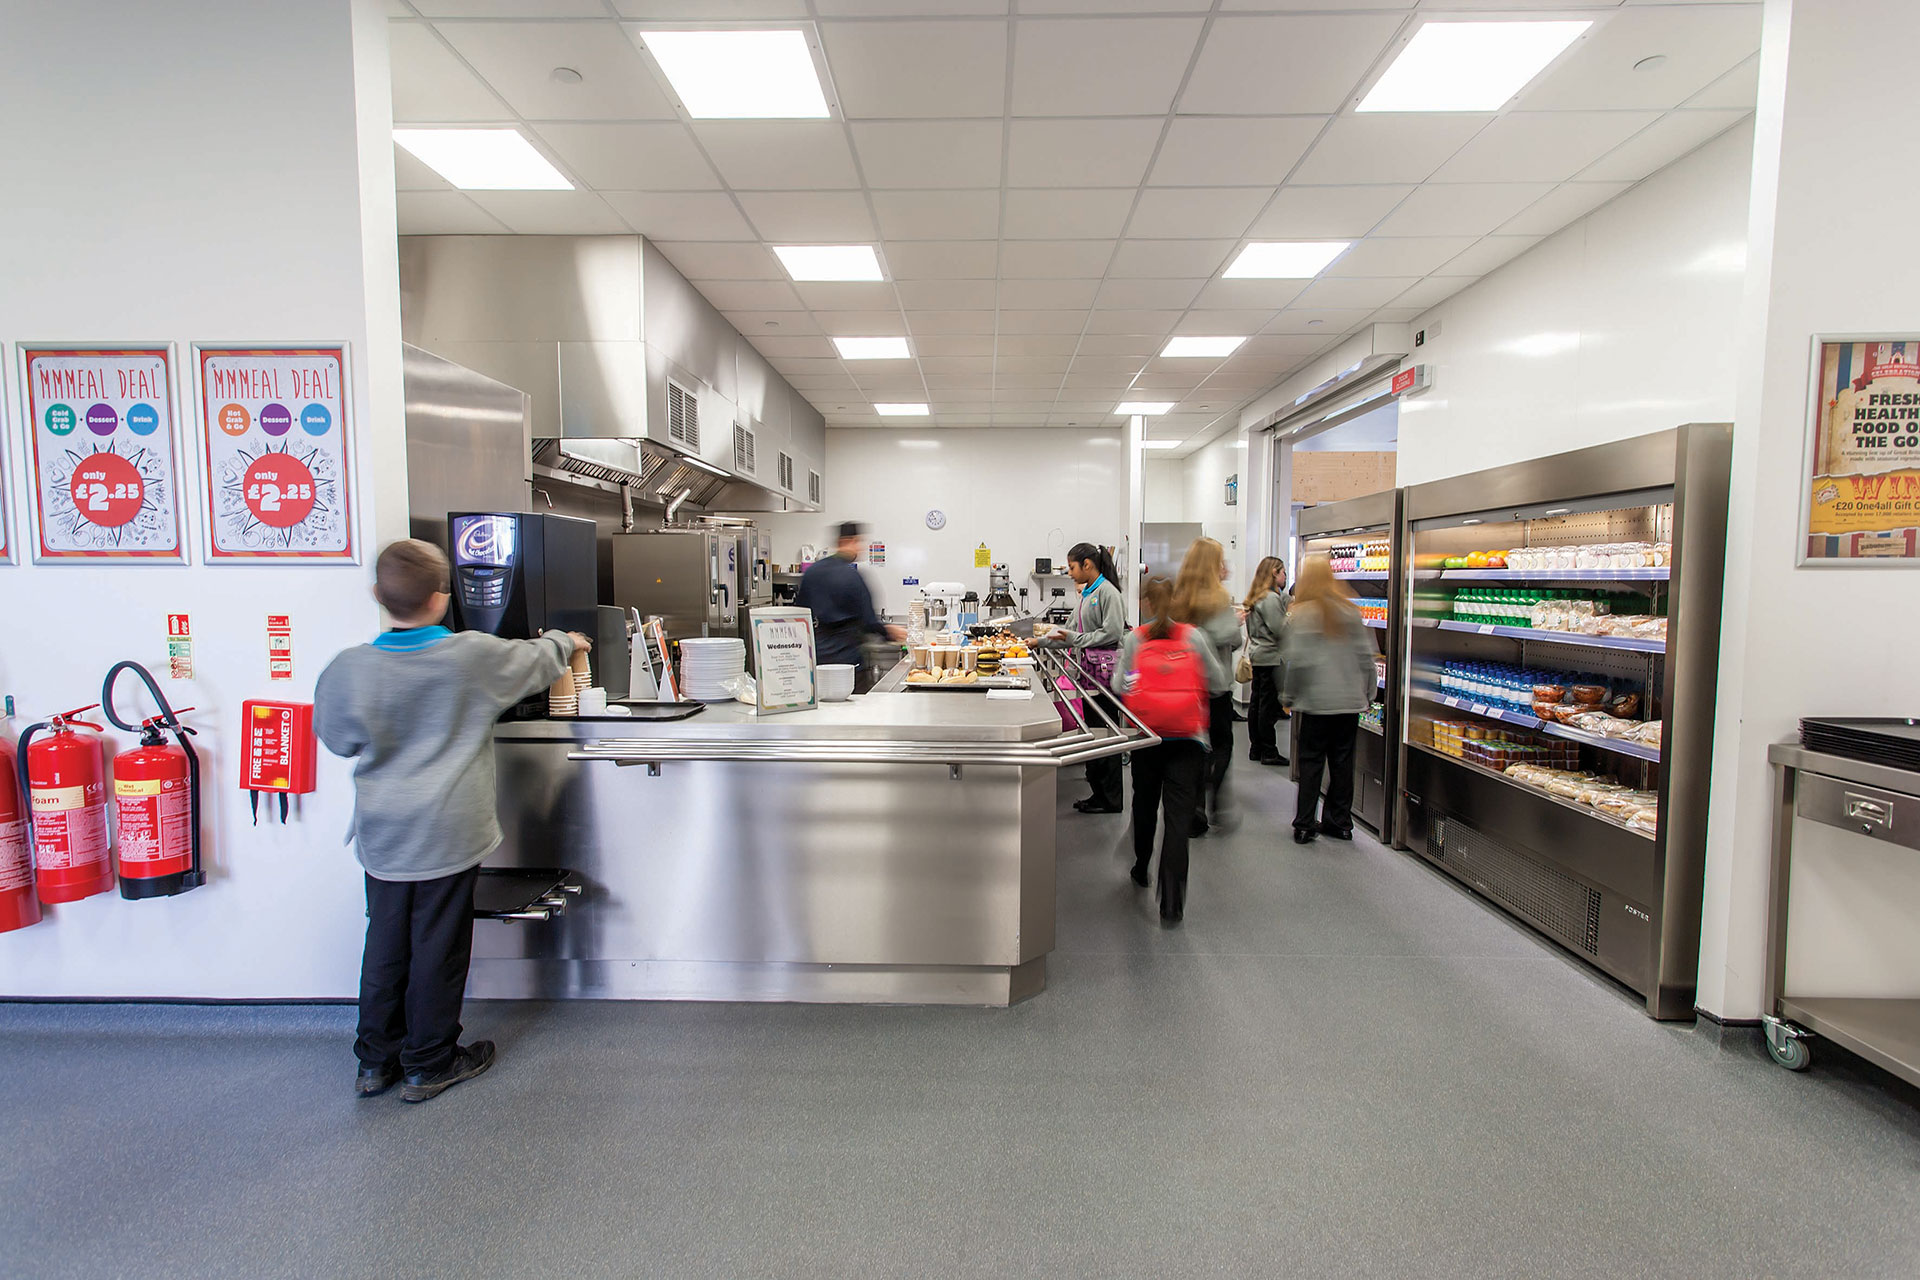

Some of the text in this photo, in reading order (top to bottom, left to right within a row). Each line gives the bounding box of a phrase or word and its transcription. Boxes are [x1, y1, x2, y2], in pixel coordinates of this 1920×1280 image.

[40, 368, 160, 399] MMMEAL DEAL
[213, 368, 333, 399] MMMEAL DEAL
[1869, 394, 1920, 406] FRESH
[88, 416, 116, 424] Dessert
[262, 416, 289, 424] Dessert
[1852, 422, 1920, 434] FOOD O
[1856, 436, 1919, 448] THE GO
[82, 471, 106, 481] only
[254, 471, 278, 481] only
[75, 483, 139, 511] £2.25
[247, 483, 311, 511] £2.25
[1835, 502, 1854, 510] £20
[1856, 501, 1891, 510] One4all
[1894, 501, 1911, 510] Gift
[767, 642, 802, 650] Wednesday
[279, 720, 290, 766] BLANKET
[252, 757, 262, 779] FIRE
